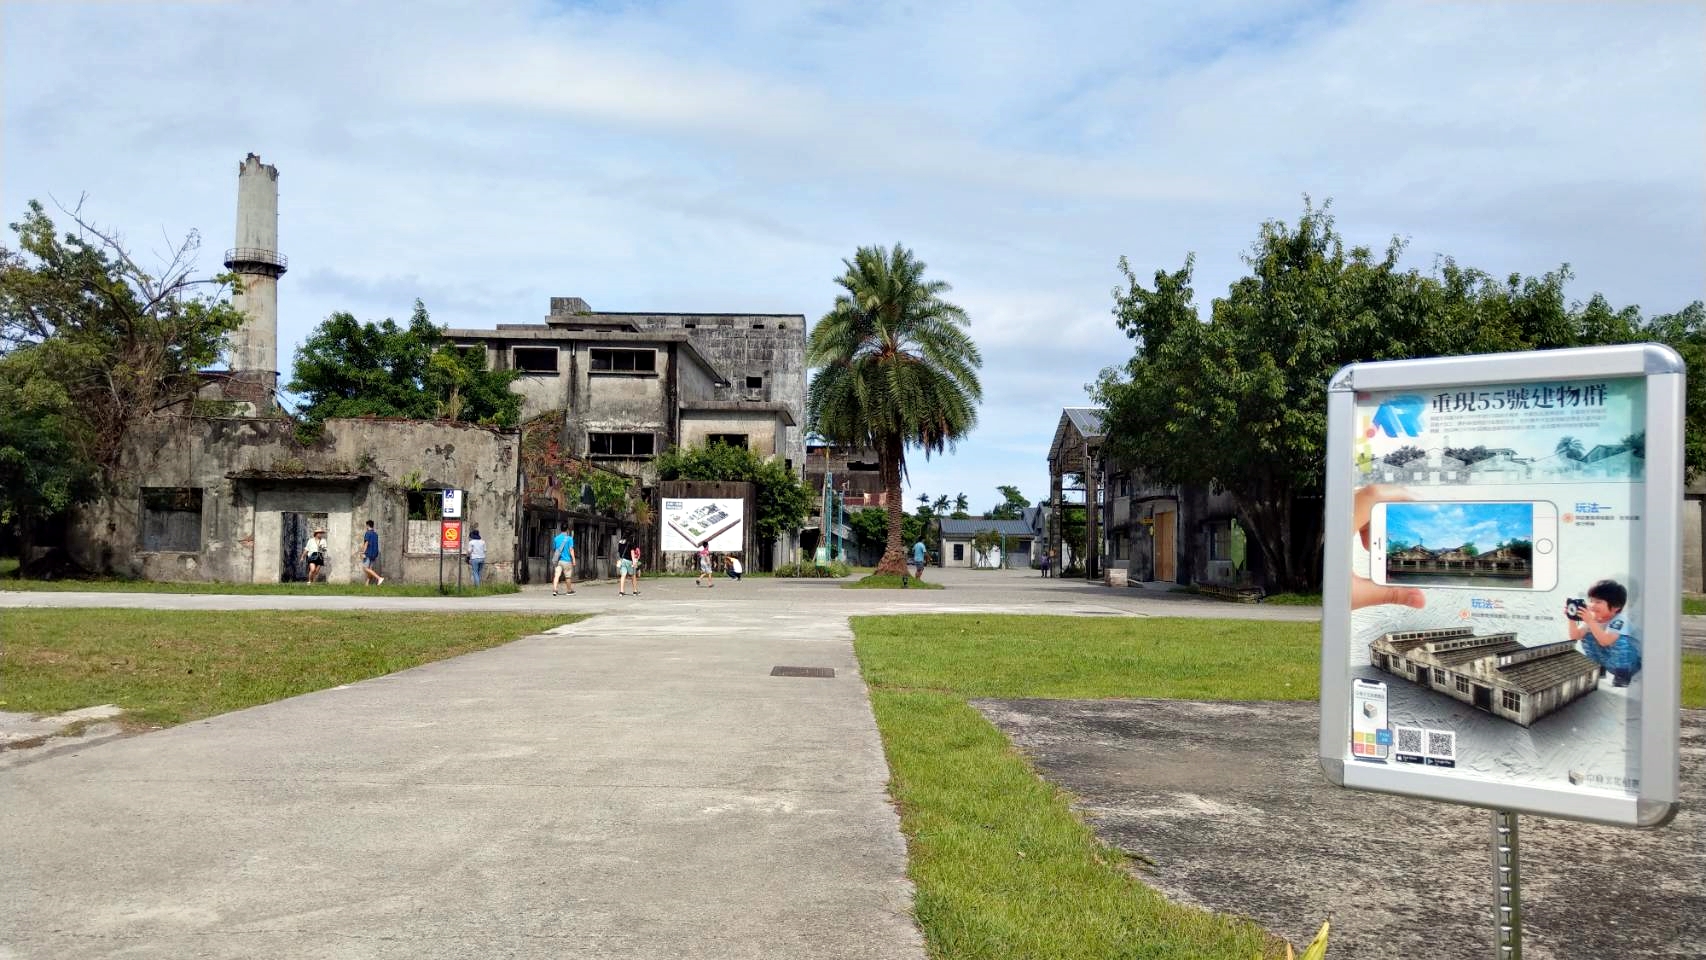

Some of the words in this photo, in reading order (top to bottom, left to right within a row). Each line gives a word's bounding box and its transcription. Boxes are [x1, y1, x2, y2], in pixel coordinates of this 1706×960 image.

[1431, 383, 1608, 414] 重現55號建物群
